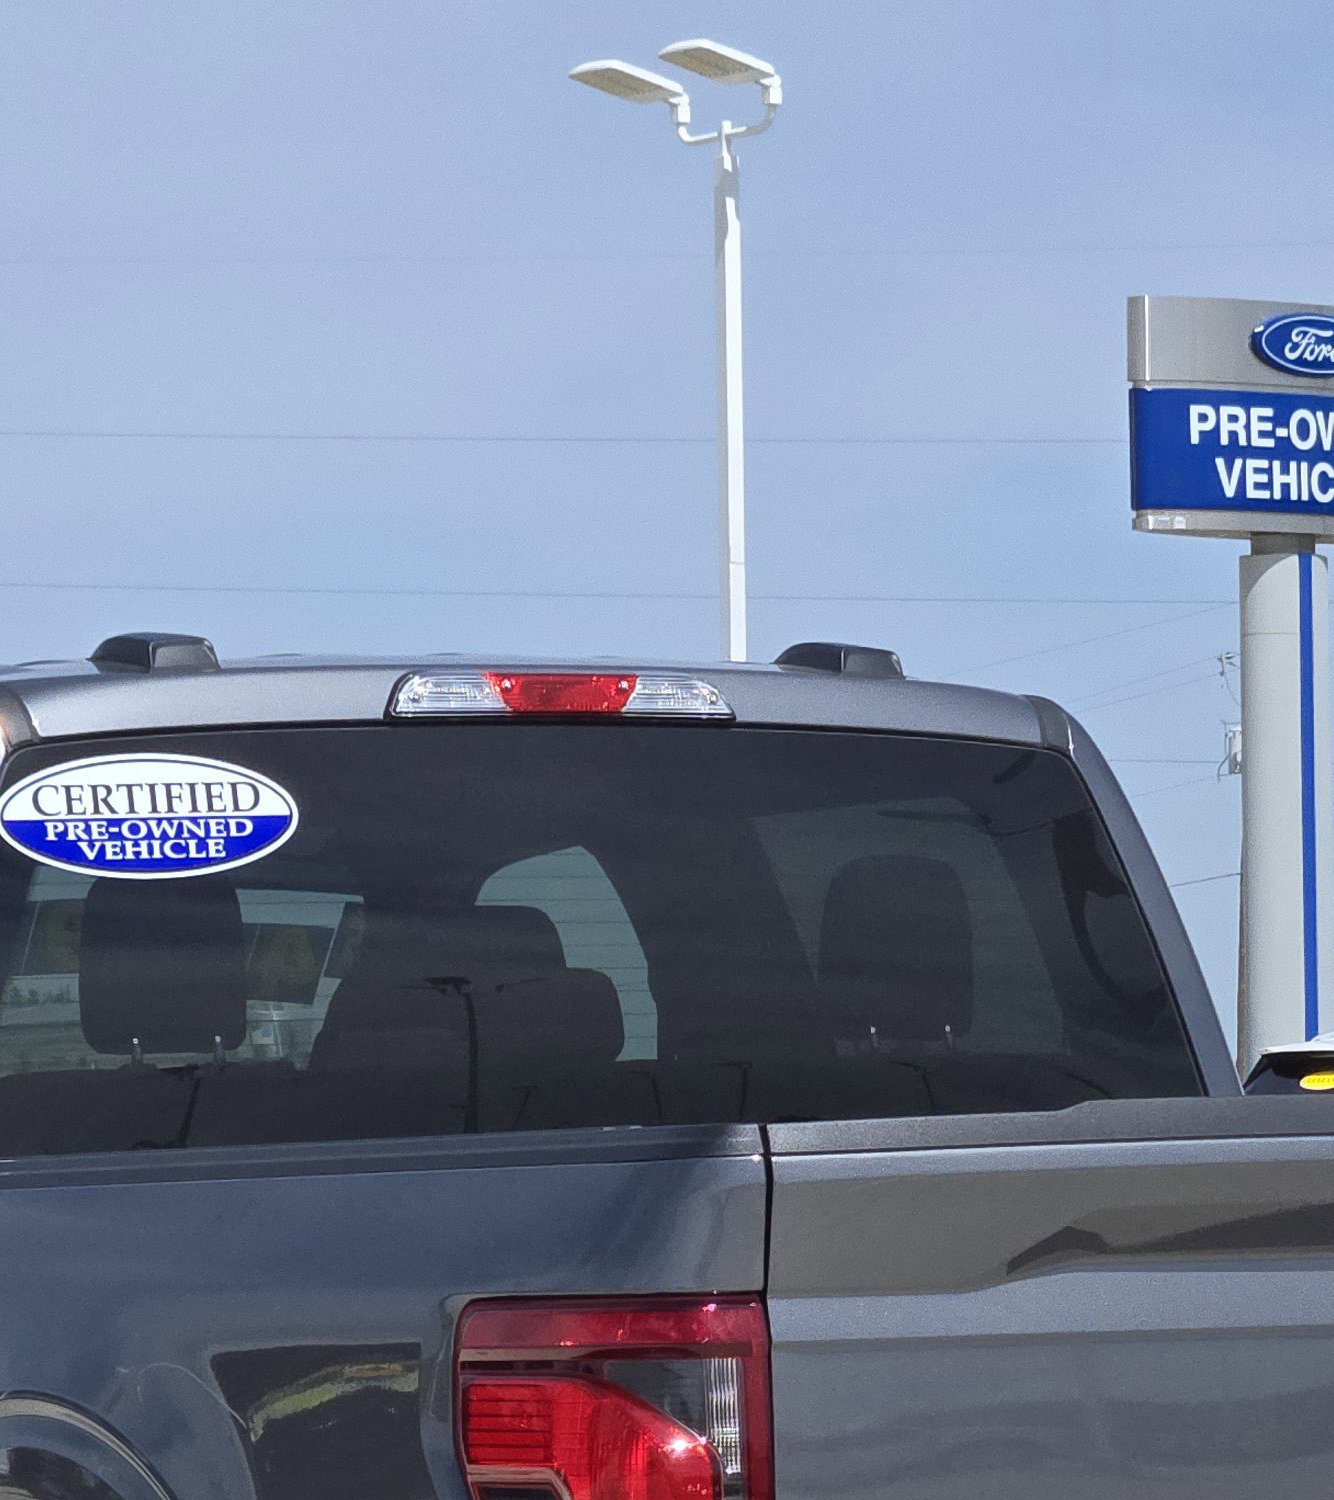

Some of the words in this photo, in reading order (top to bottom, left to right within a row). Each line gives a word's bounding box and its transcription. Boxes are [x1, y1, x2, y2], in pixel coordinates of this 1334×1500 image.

[31, 781, 260, 817] CERTIFIED
[44, 818, 254, 842] PRE-OWNED
[77, 838, 227, 861] VEHICLE
